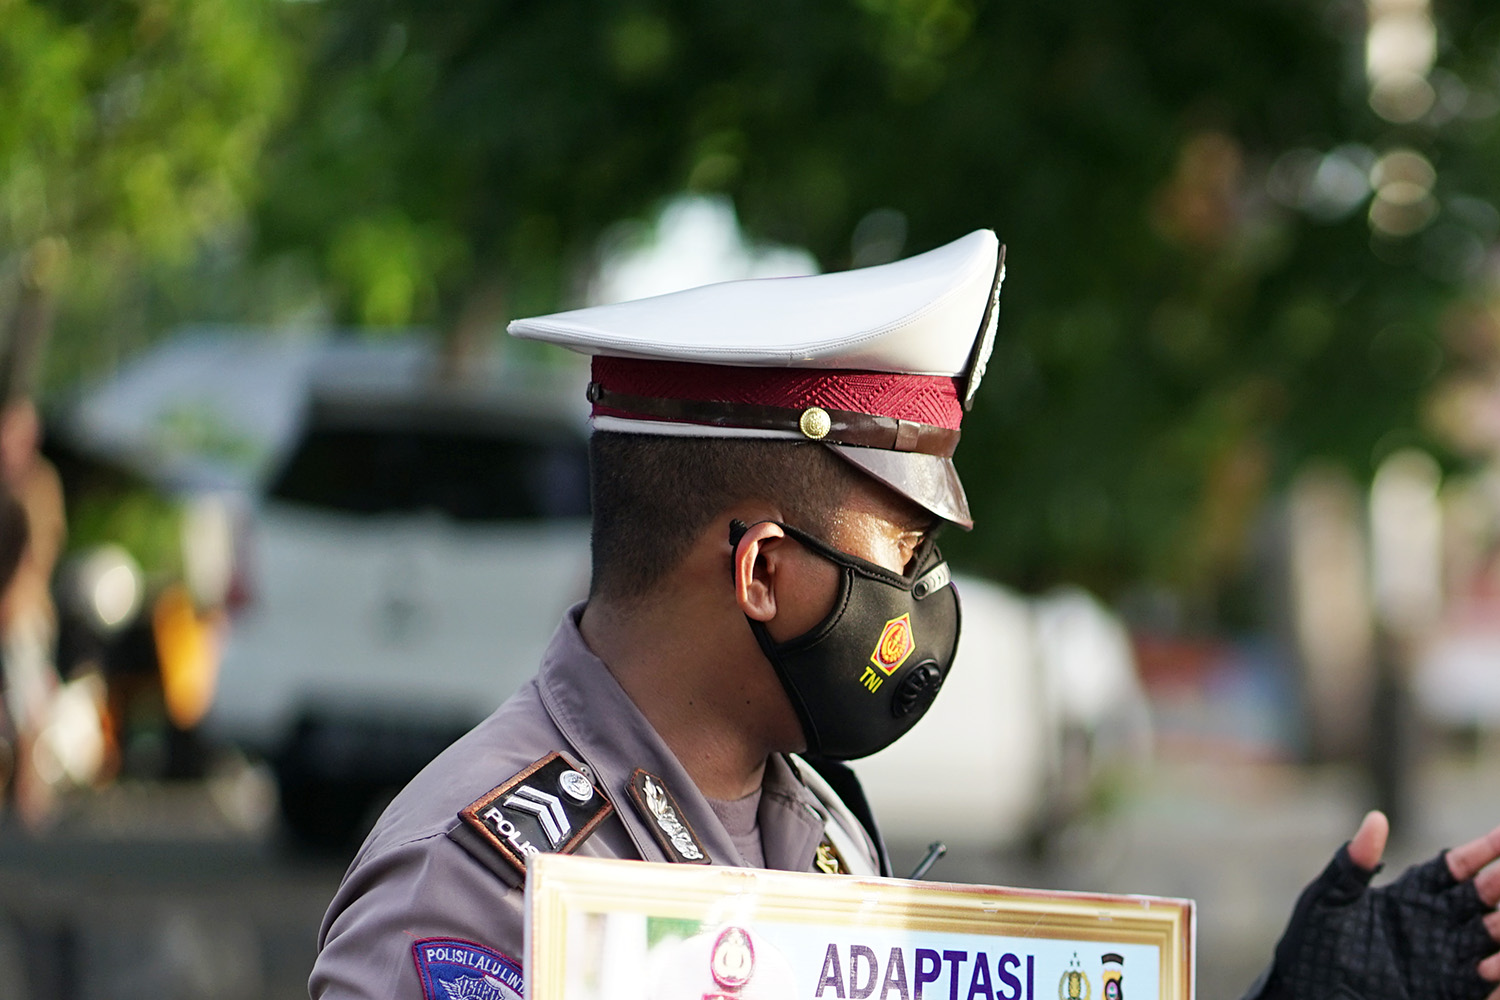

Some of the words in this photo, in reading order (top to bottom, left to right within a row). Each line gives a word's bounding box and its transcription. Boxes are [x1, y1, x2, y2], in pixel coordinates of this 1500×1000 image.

[859, 666, 884, 694] TNI
[484, 807, 540, 857] POLIS
[426, 948, 467, 965] POLISI
[468, 953, 501, 974] LALU
[500, 967, 525, 994] LINT
